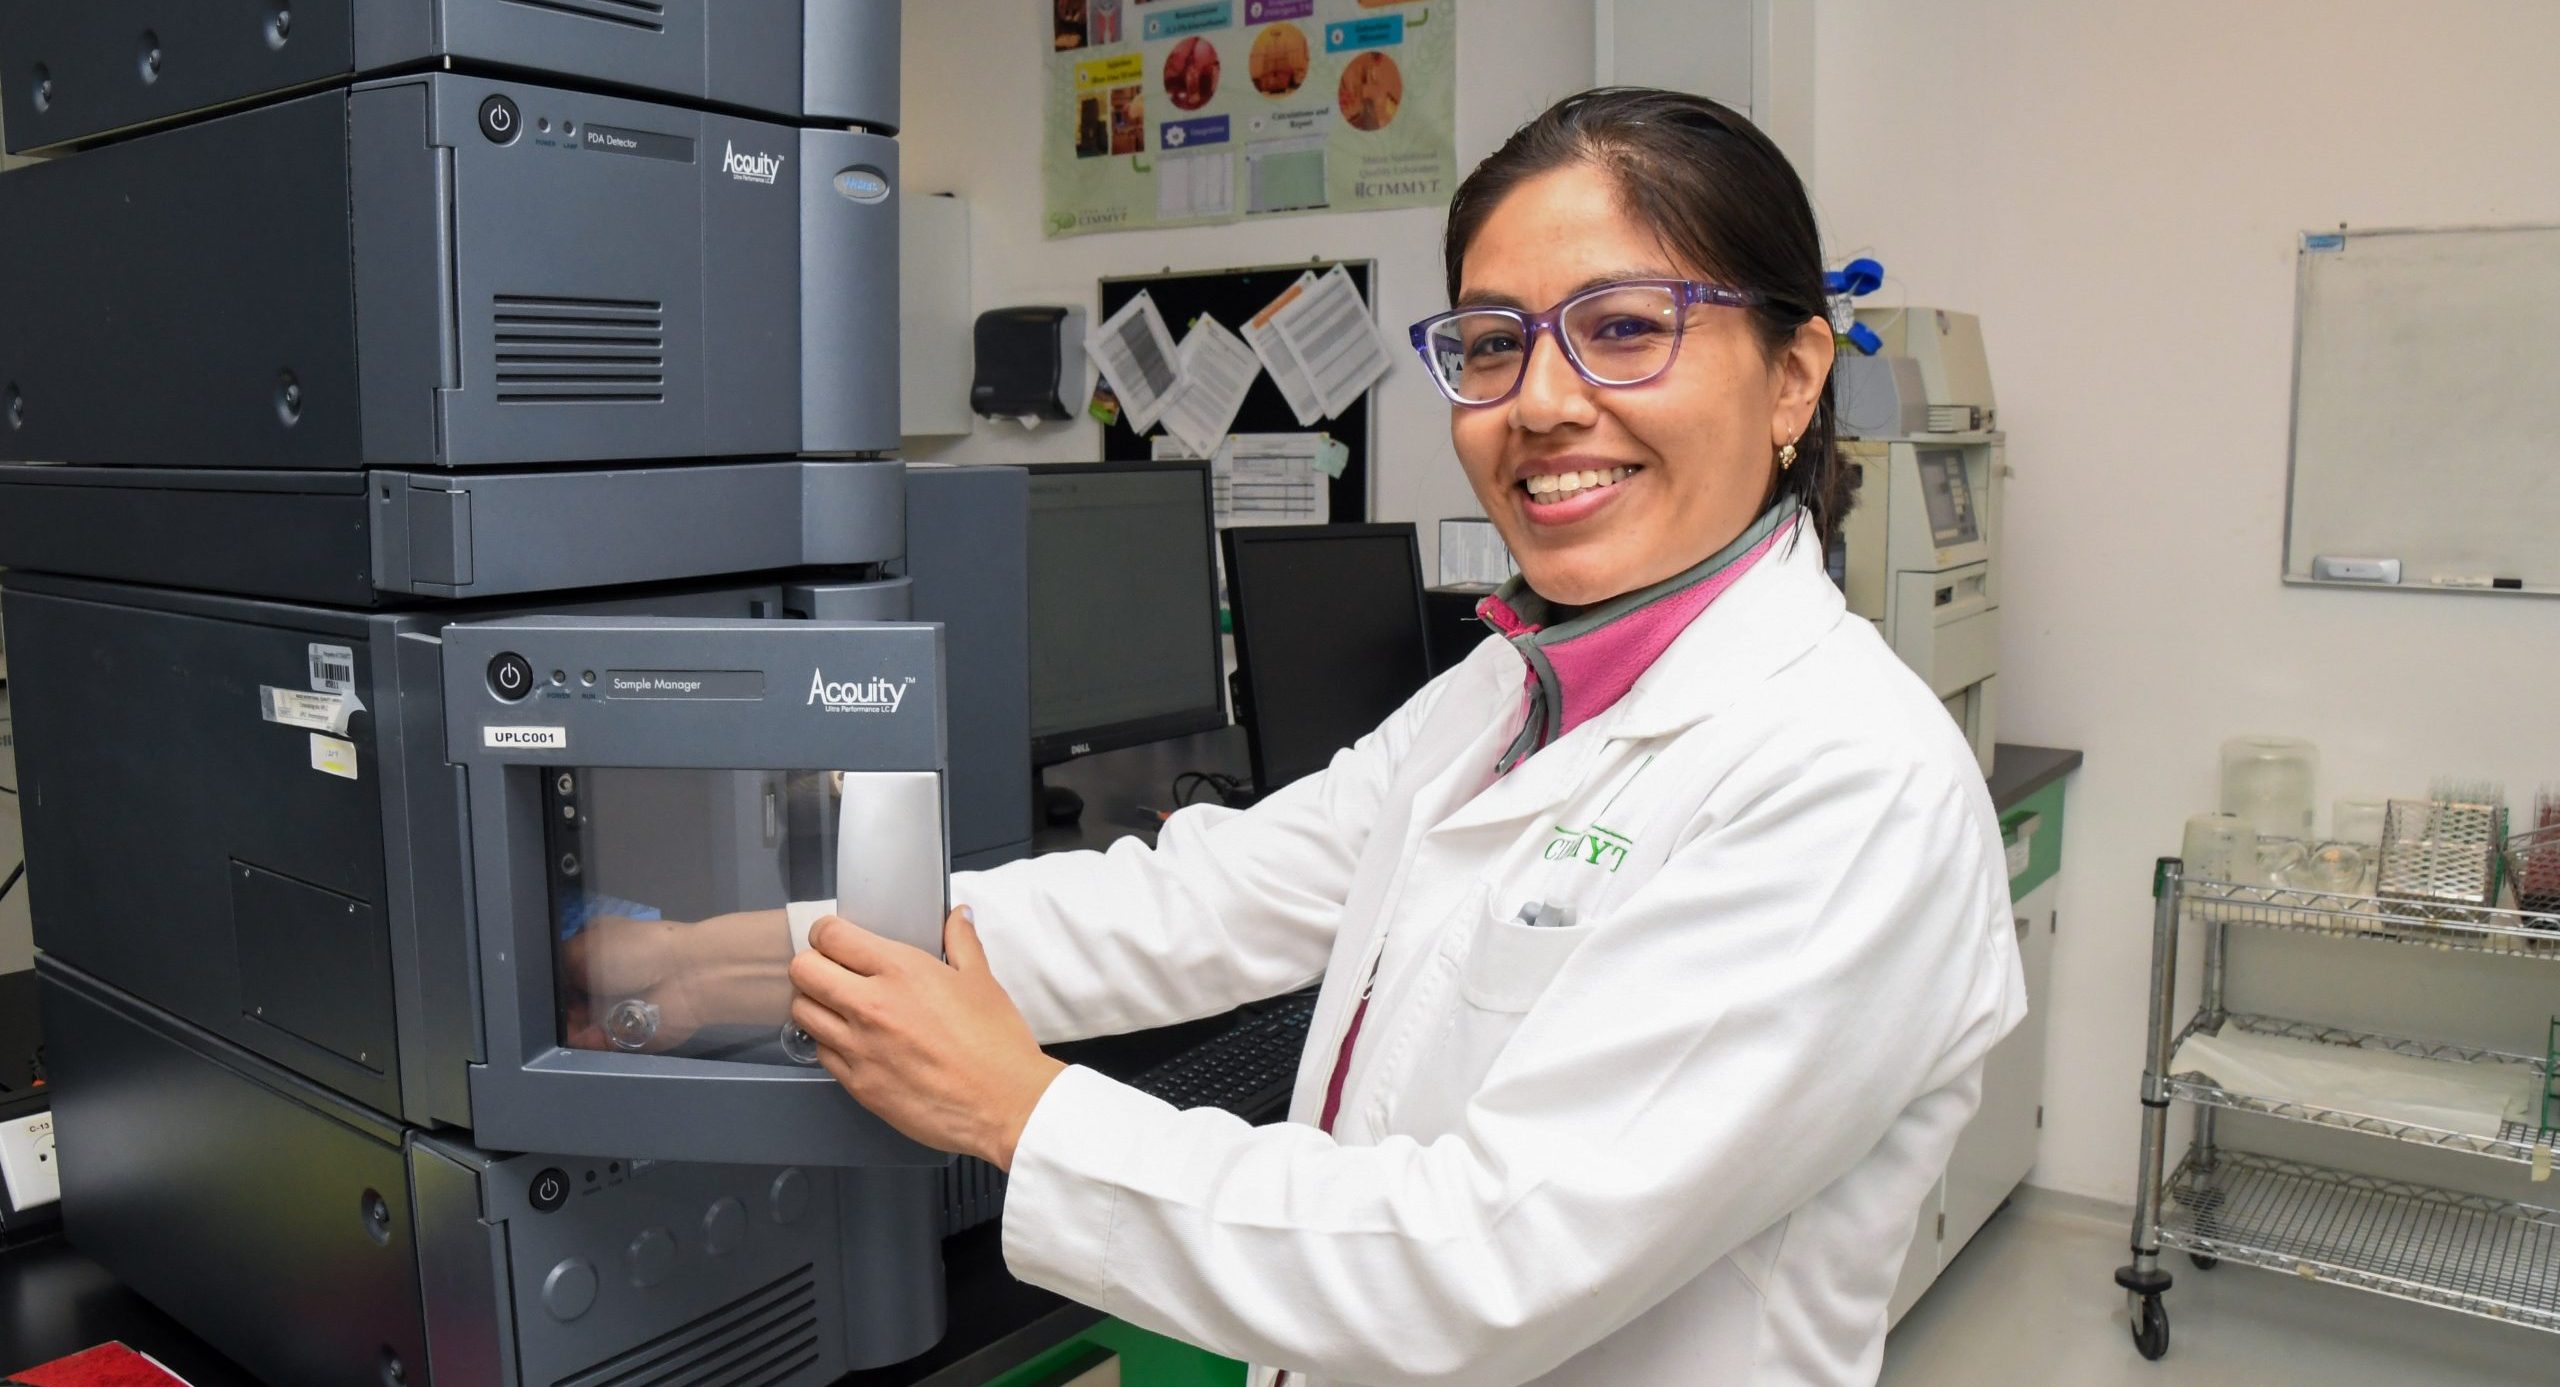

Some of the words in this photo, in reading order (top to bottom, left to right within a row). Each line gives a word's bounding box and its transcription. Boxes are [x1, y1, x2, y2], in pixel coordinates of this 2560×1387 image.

[588, 132, 605, 145] PDA
[607, 135, 638, 149] Detector
[1366, 178, 1441, 197] CIMMYT
[614, 678, 651, 692] Sample
[654, 679, 701, 692] Manager
[825, 705, 840, 713] Ultra
[841, 705, 880, 713] Performance
[495, 732, 554, 743] UPLC001
[29, 1122, 50, 1133] C-13
